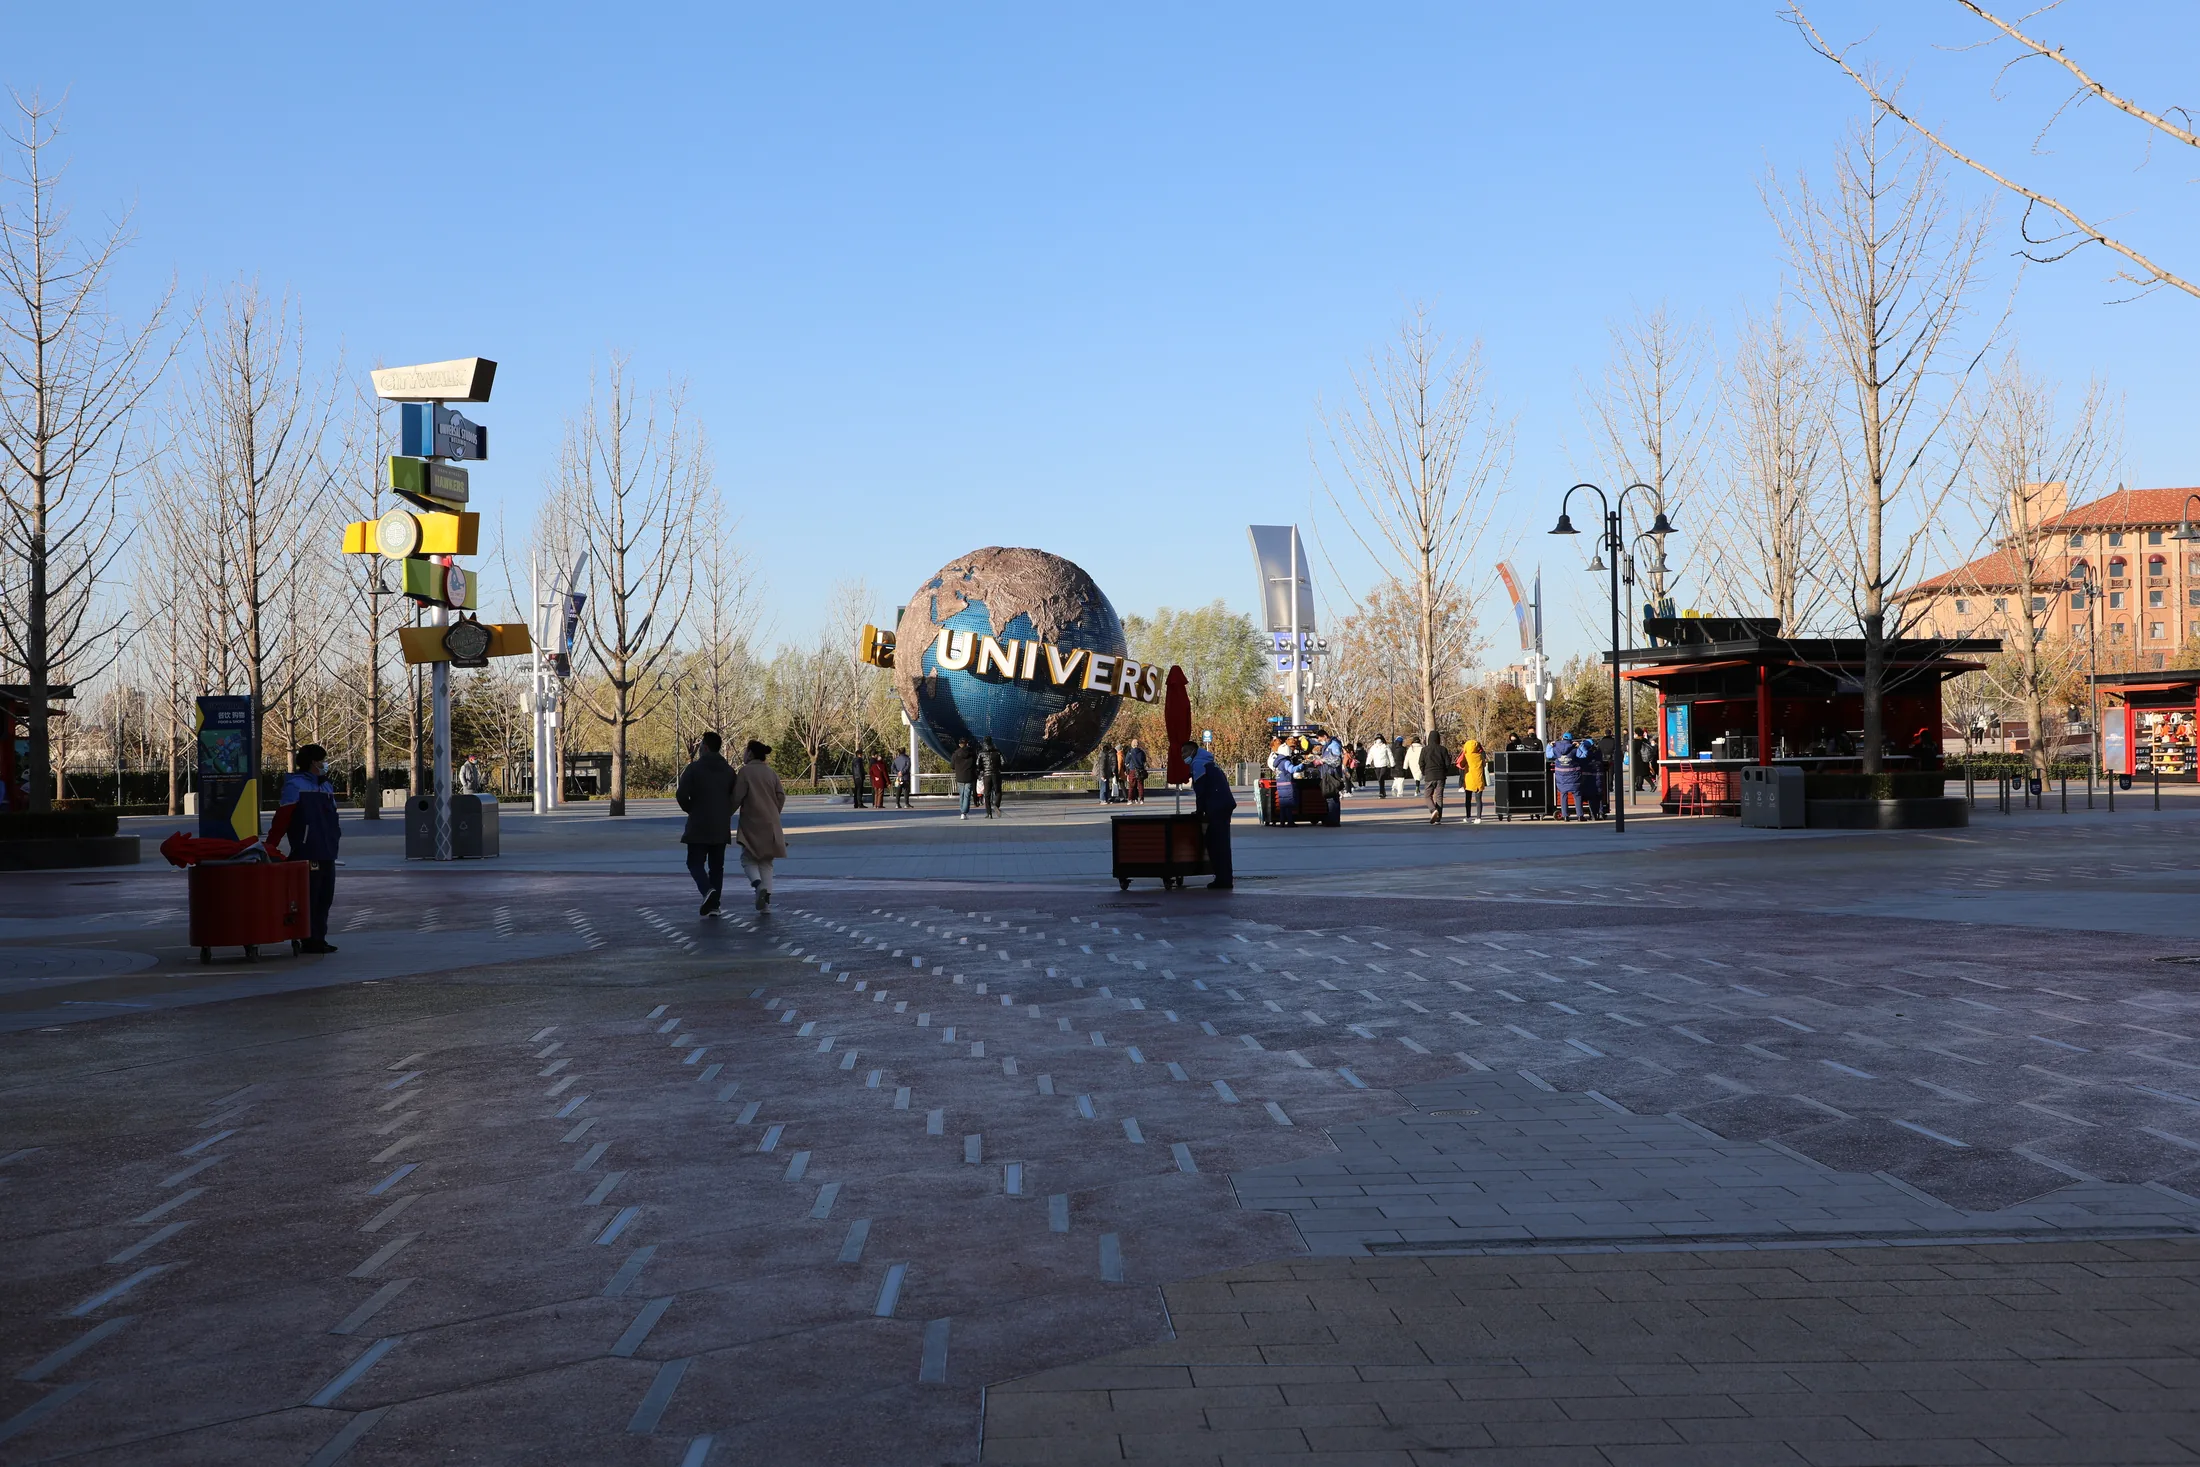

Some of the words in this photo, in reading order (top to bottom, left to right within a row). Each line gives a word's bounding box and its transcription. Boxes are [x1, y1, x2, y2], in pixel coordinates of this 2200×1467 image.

[440, 424, 461, 438] UNIVERSAL
[434, 474, 465, 494] HAWKERS
[936, 628, 1164, 704] UNIVERS
